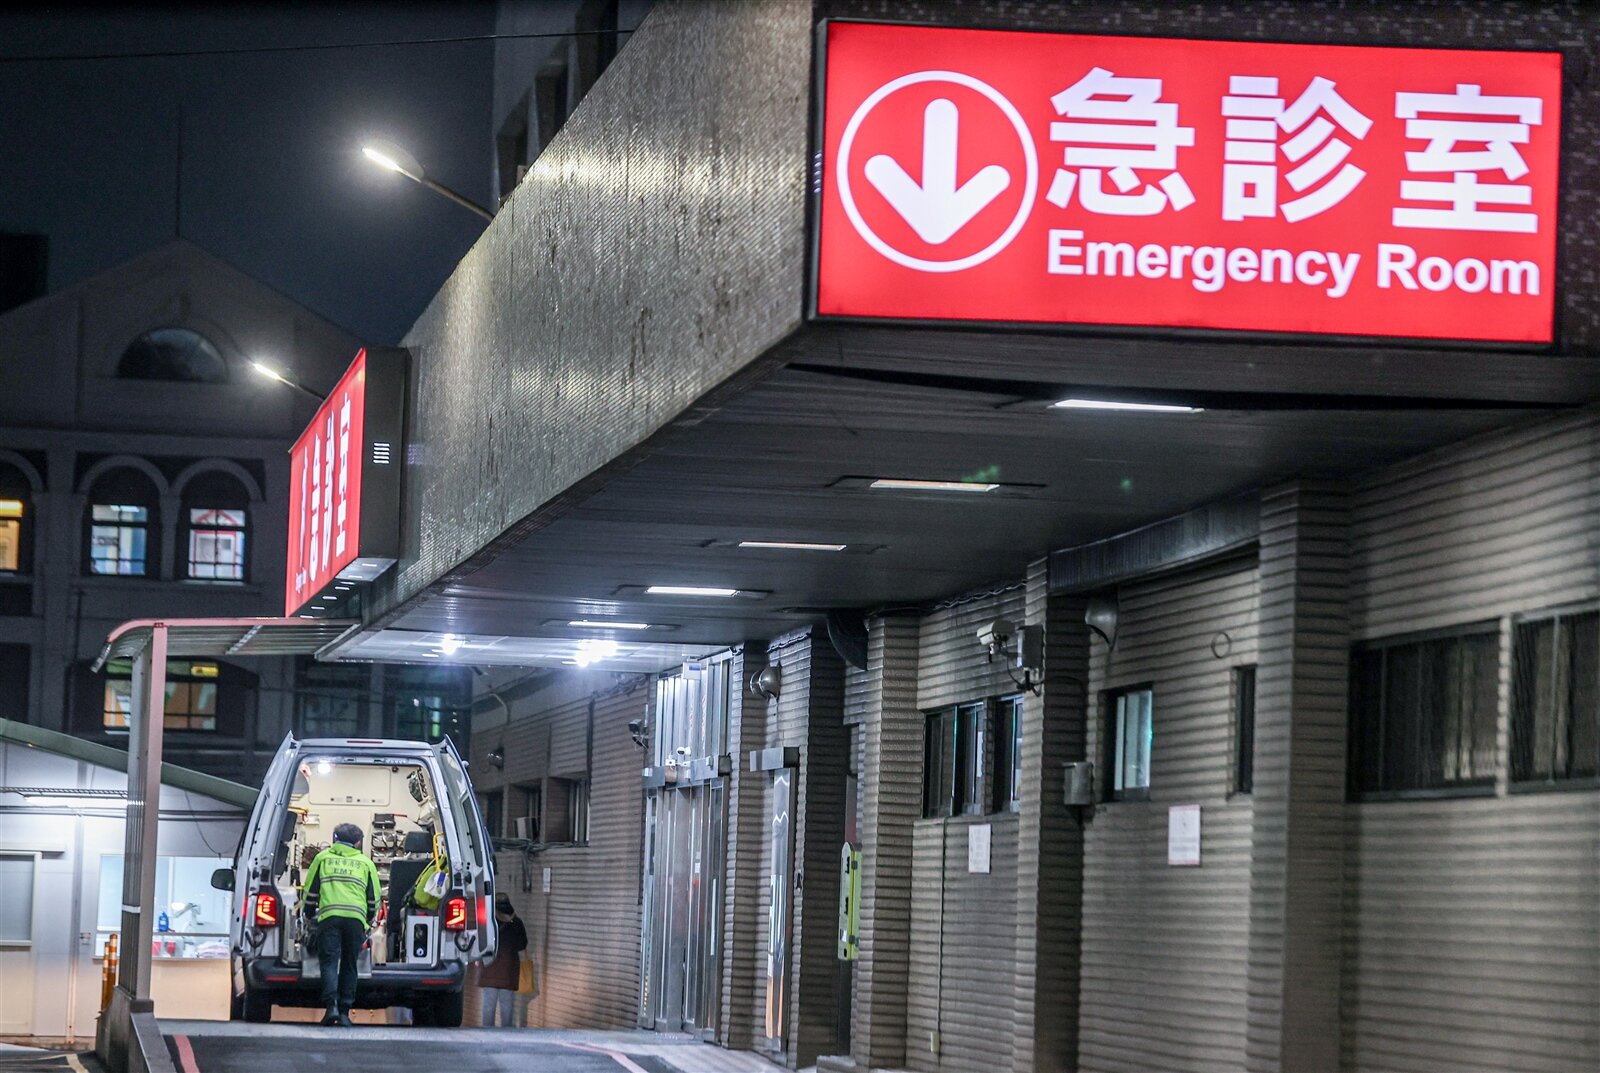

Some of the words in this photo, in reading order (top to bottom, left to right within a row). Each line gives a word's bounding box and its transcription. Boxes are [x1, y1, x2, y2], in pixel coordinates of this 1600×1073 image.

[1047, 67, 1543, 234] 急診室
[1047, 229, 1361, 298] Emergency
[1377, 242, 1540, 297] Room
